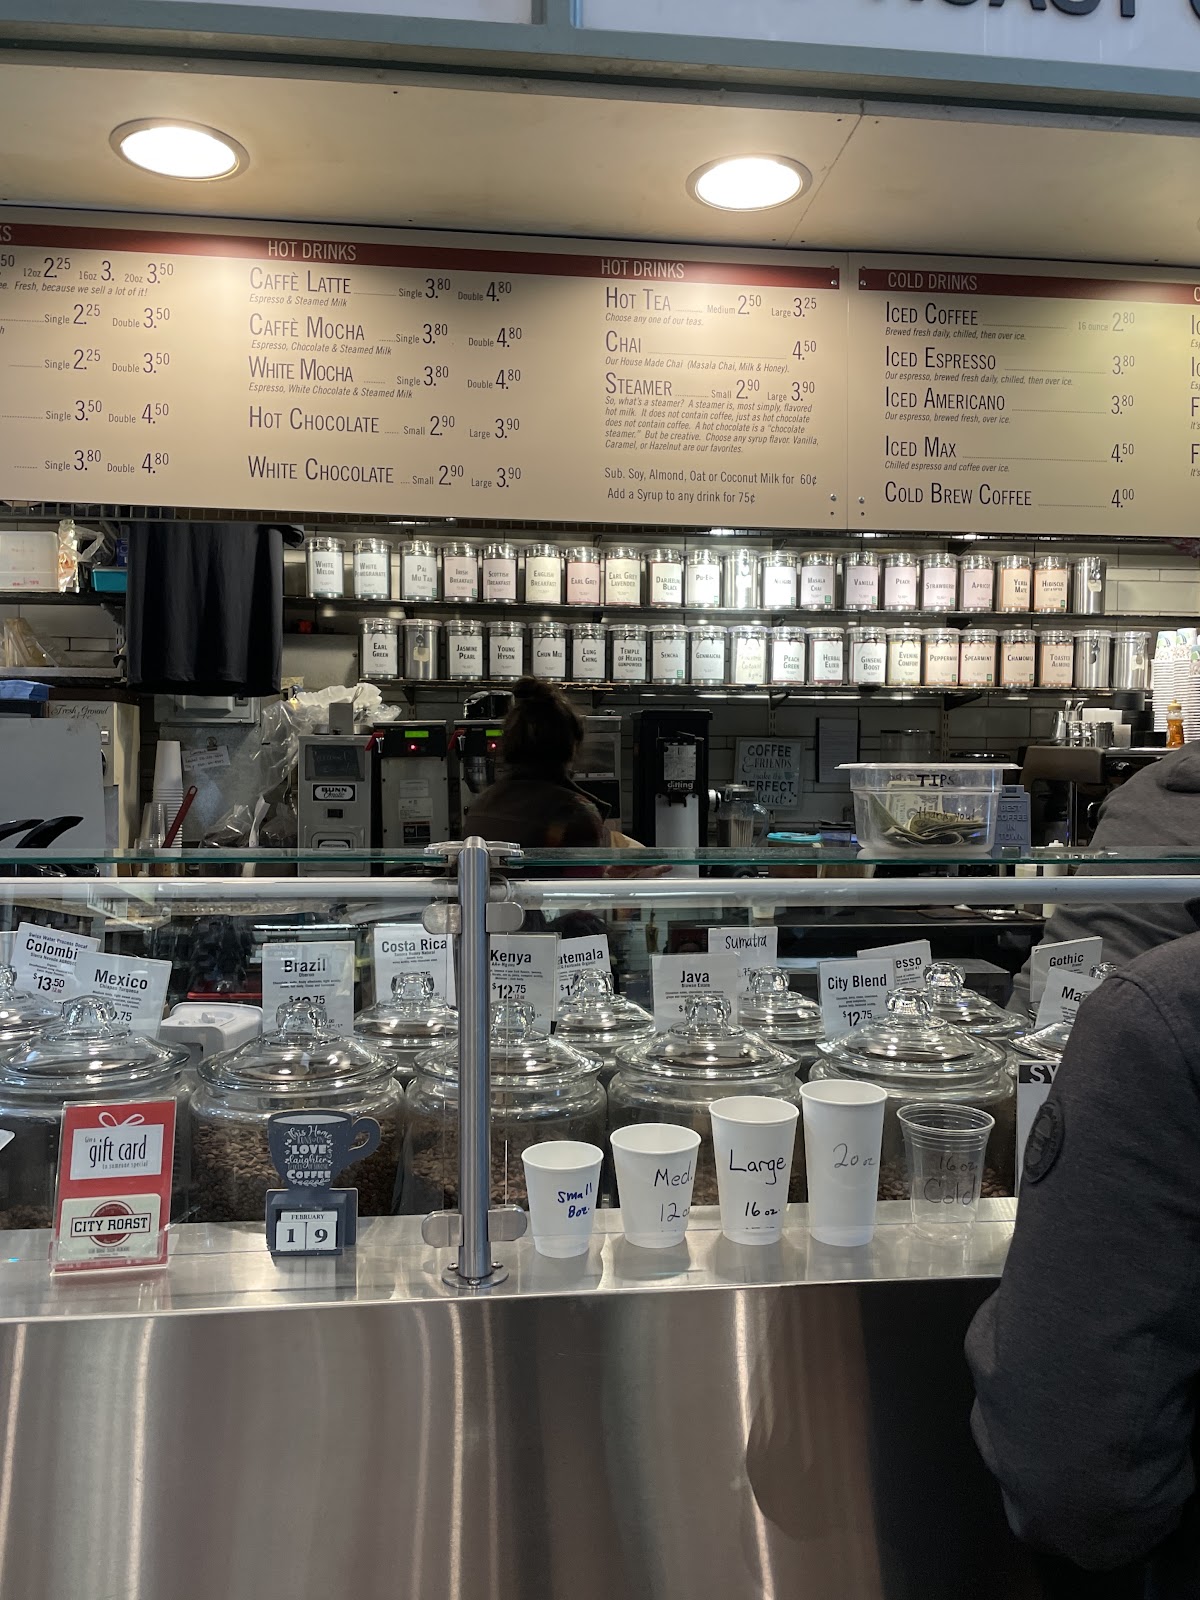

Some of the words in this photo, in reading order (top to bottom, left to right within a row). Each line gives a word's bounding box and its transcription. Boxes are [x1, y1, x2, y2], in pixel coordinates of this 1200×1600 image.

[268, 241, 298, 257] HOT
[302, 243, 357, 260] DRINKS
[23, 268, 42, 278] 12oz
[44, 257, 71, 278] 2.25
[79, 270, 98, 281] 16oz
[124, 273, 143, 284] 20oz
[146, 263, 174, 284] 3.50
[601, 258, 629, 276] HOT
[634, 260, 684, 279] DRINKS
[398, 288, 422, 300] Single
[425, 278, 451, 299] 3.80
[458, 292, 484, 301] Double
[486, 282, 512, 302] 4.80
[888, 272, 924, 288] COLD
[928, 274, 978, 290] DRINKS
[44, 314, 70, 325] Single
[73, 304, 100, 325] 2.25
[112, 317, 140, 328] Double
[144, 308, 170, 328] 3.50
[707, 304, 736, 314] Medium
[738, 294, 762, 315] 2.50
[772, 308, 792, 318] Large
[793, 297, 816, 318] 3.25
[1078, 321, 1086, 330] 16
[1088, 323, 1108, 332] ounce
[1112, 312, 1135, 332] 2.80
[395, 333, 420, 344] Single
[422, 324, 448, 344] 3.80
[468, 338, 494, 348] Double
[496, 328, 522, 348] 4.80
[792, 340, 816, 360] 4.50
[1112, 355, 1135, 375] 3.80
[396, 376, 421, 387] Single
[423, 366, 449, 387] 3.80
[467, 380, 493, 390] Double
[496, 369, 521, 390] 4.80
[711, 389, 732, 400] Small
[736, 379, 760, 400] 2.90
[768, 391, 788, 402] Large
[792, 381, 815, 402] 3.90
[1111, 395, 1134, 415] 3.80
[403, 426, 426, 436] Small
[430, 416, 456, 436] 2.90
[469, 428, 490, 440] Large
[494, 418, 520, 439] 3.90
[1111, 443, 1134, 464] 4.50
[412, 476, 434, 486] Small
[438, 464, 464, 486] 2.90
[471, 478, 492, 489] Large
[496, 467, 522, 488] 3.90
[604, 467, 626, 479] Sub.
[628, 468, 646, 482] Soy,
[649, 469, 687, 482] Almond,
[690, 471, 706, 482] Oat
[708, 474, 718, 483] or
[720, 472, 758, 484] Coconut
[760, 472, 780, 484] Milk
[782, 474, 794, 485] for
[800, 474, 818, 486] 60¢
[1111, 488, 1135, 508] 4.00
[748, 744, 791, 758] COFFEE
[754, 758, 792, 769] FRIENDS
[917, 774, 954, 787] TIPS
[1001, 804, 1022, 812] BEST
[26, 938, 78, 960] Colombi
[382, 940, 416, 954] Costa
[420, 938, 448, 950] Rica
[725, 934, 768, 950] Sumatra
[284, 958, 326, 973] Brazil
[490, 950, 532, 966] Kenya
[1050, 952, 1084, 967] Gothic
[33, 972, 65, 992] $13.50
[94, 969, 148, 990] Mexico
[681, 970, 710, 984] Java
[828, 976, 848, 992] City
[852, 974, 887, 988] Blend
[492, 982, 526, 999] $12.75
[842, 1010, 872, 1027] $12.75
[89, 1136, 113, 1168] gift
[118, 1134, 147, 1160] card
[292, 1144, 326, 1154] LOVE
[833, 1143, 859, 1168] 20
[288, 1154, 327, 1168] laughter
[729, 1149, 786, 1185] Large
[939, 1157, 956, 1172] 16
[286, 1169, 332, 1178] COFFEE
[654, 1160, 694, 1187] Med.
[924, 1177, 976, 1206] Cold
[660, 1202, 680, 1222] 12
[745, 1202, 760, 1217] 16
[74, 1220, 104, 1233] CITY
[108, 1217, 148, 1231] ROAST
[286, 1228, 296, 1244] 1
[314, 1228, 328, 1244] 9
